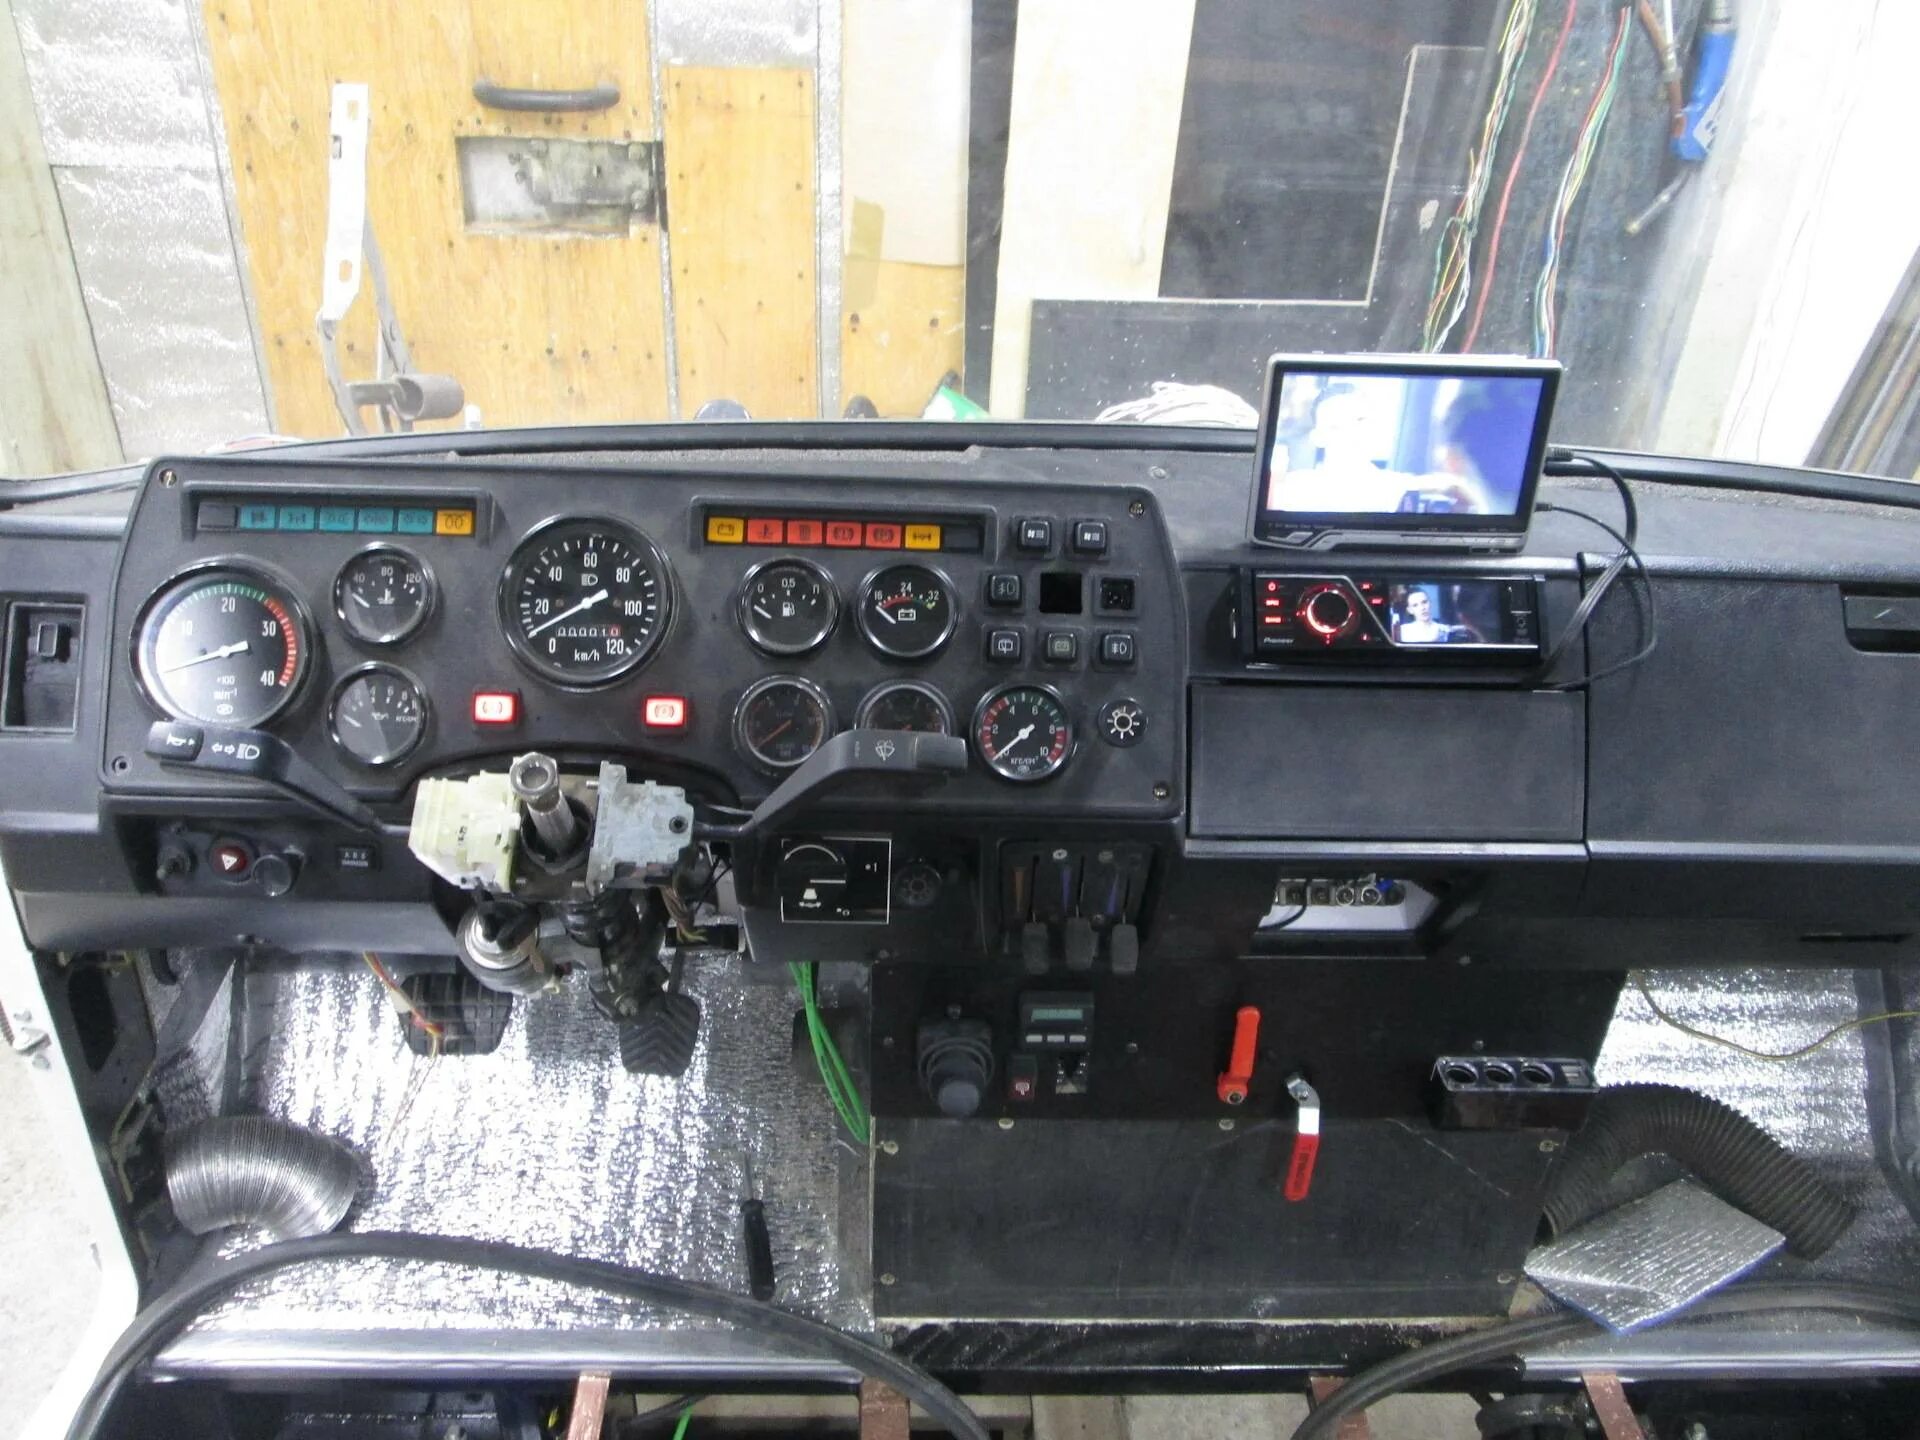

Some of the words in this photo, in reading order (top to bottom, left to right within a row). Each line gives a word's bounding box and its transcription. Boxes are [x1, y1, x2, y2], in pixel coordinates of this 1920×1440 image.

[583, 552, 598, 568] 60
[381, 566, 394, 577] 80
[548, 566, 562, 582] 40
[616, 567, 630, 583] 80
[757, 583, 765, 593] 0
[900, 582, 912, 592] 24
[874, 590, 883, 600] 16
[928, 591, 939, 601] 32
[221, 597, 236, 613] 20
[535, 598, 549, 615] 20
[624, 600, 642, 616] 100
[181, 620, 193, 636] 10
[262, 620, 276, 637] 30
[548, 638, 556, 654] 0
[606, 639, 625, 655] 120
[574, 649, 600, 662] km/h
[260, 670, 275, 686] 40
[1009, 706, 1015, 715] 4
[1032, 706, 1039, 715] 6
[992, 724, 998, 734] 2
[1049, 724, 1056, 734] 8
[1040, 746, 1048, 757] 10
